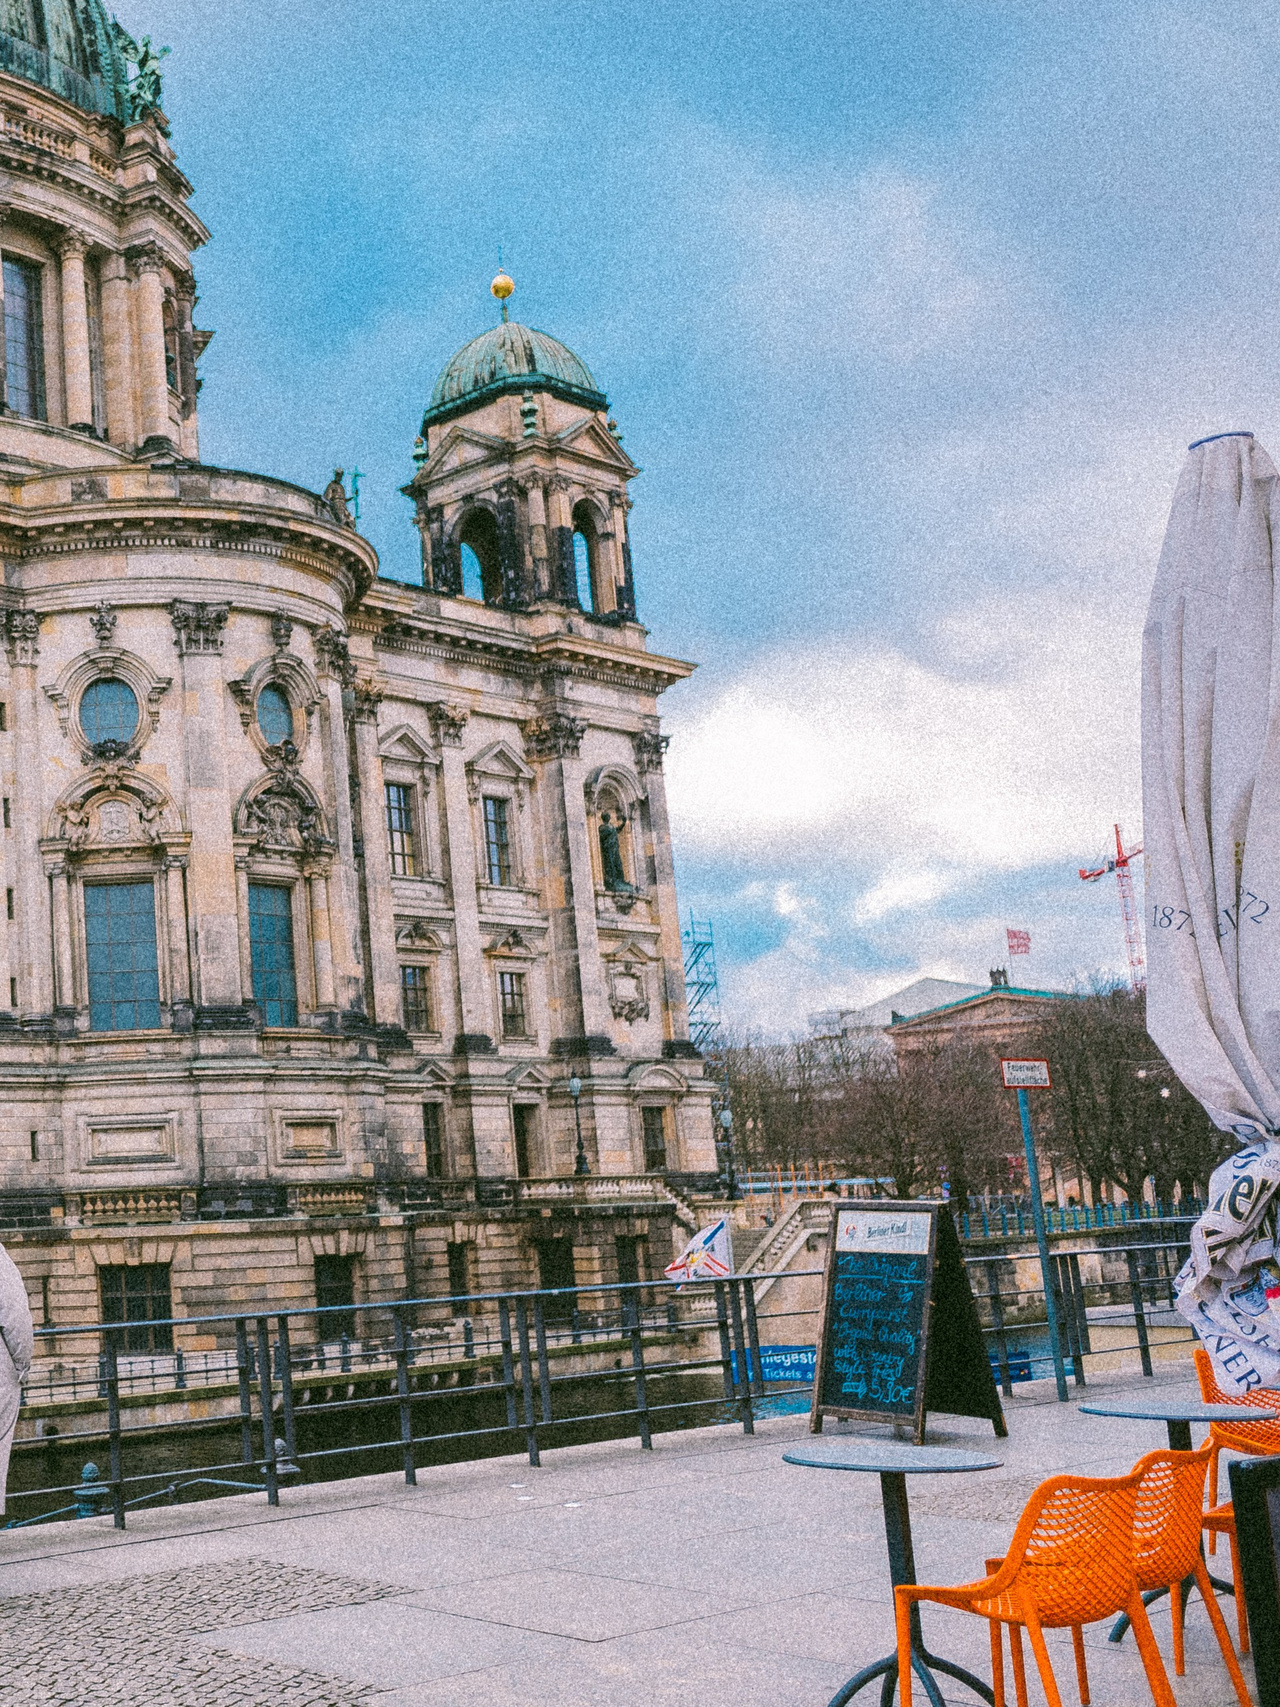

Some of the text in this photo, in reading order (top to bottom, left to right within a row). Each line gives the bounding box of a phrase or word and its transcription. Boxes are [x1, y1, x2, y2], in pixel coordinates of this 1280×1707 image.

[1152, 904, 1196, 940] 187
[834, 1282, 887, 1302] Berliner
[833, 1344, 859, 1361] with
[764, 1368, 802, 1379] Tickets
[869, 1378, 915, 1404] 5,90€
